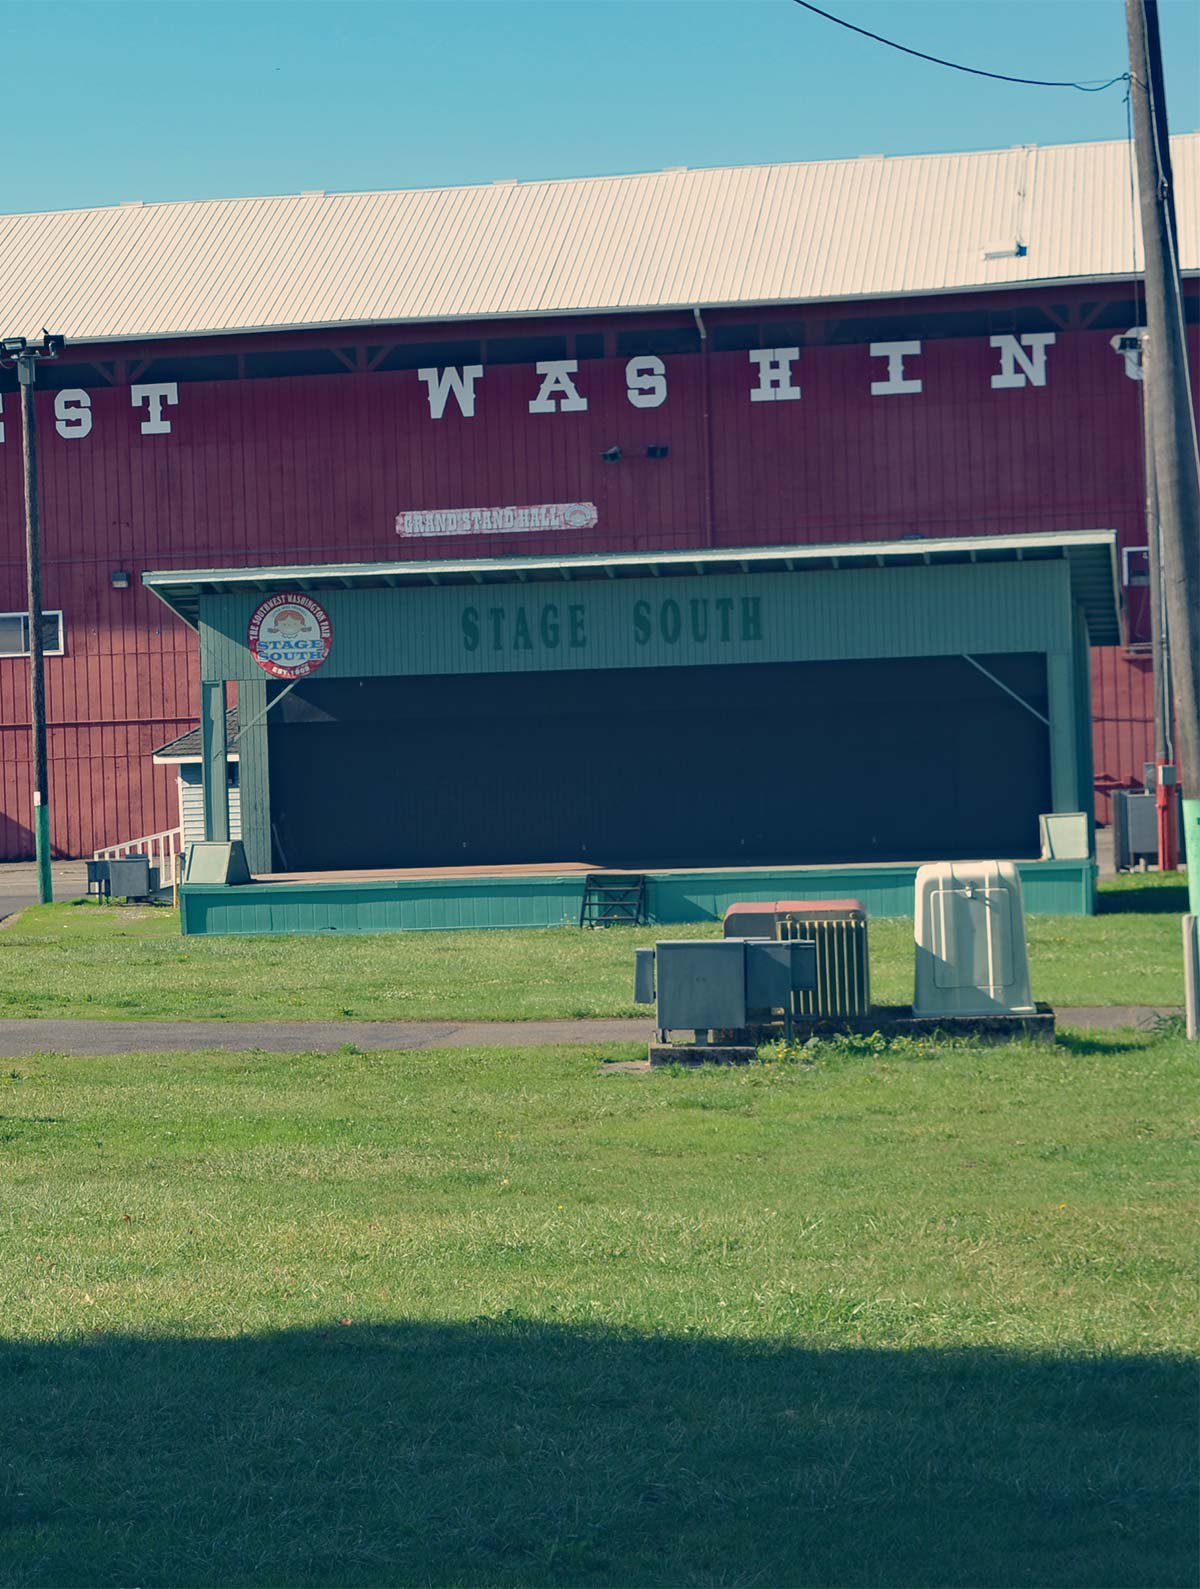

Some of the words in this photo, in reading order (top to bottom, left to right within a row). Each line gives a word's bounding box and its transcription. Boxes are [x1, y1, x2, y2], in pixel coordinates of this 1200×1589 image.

[404, 512, 457, 534] GRAND
[462, 509, 515, 531] STAND
[520, 506, 560, 528] HALL
[252, 595, 286, 625] SOUTHWEST
[287, 593, 327, 622] WASHINGTON
[249, 624, 259, 641] THE
[462, 604, 588, 652] STAGE
[633, 596, 763, 645] SOUTH
[257, 639, 323, 650] STAGE
[258, 651, 322, 661] SOUTH
